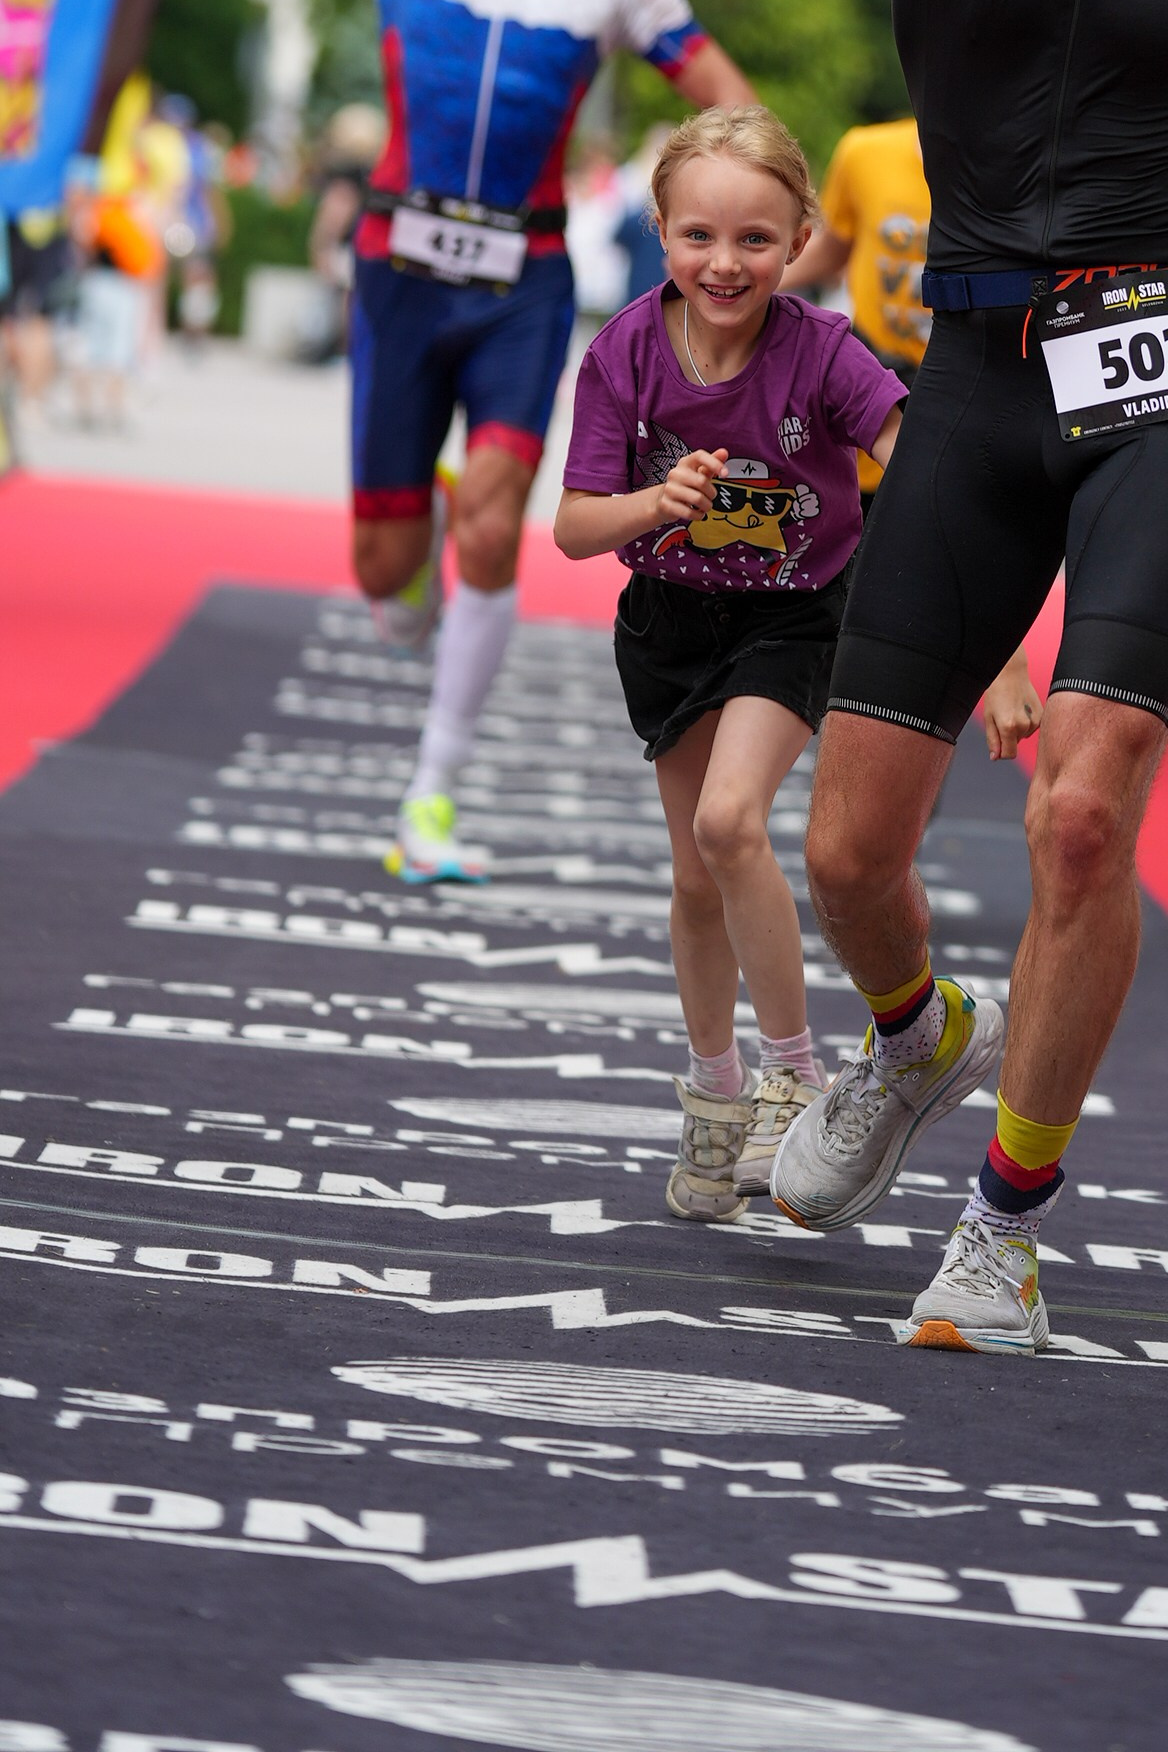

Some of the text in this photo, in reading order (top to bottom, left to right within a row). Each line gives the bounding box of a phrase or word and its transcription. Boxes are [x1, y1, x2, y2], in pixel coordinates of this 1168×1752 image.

[1102, 288, 1128, 306] IRON
[1138, 281, 1166, 298] STAR
[0, 1472, 425, 1553] ON
